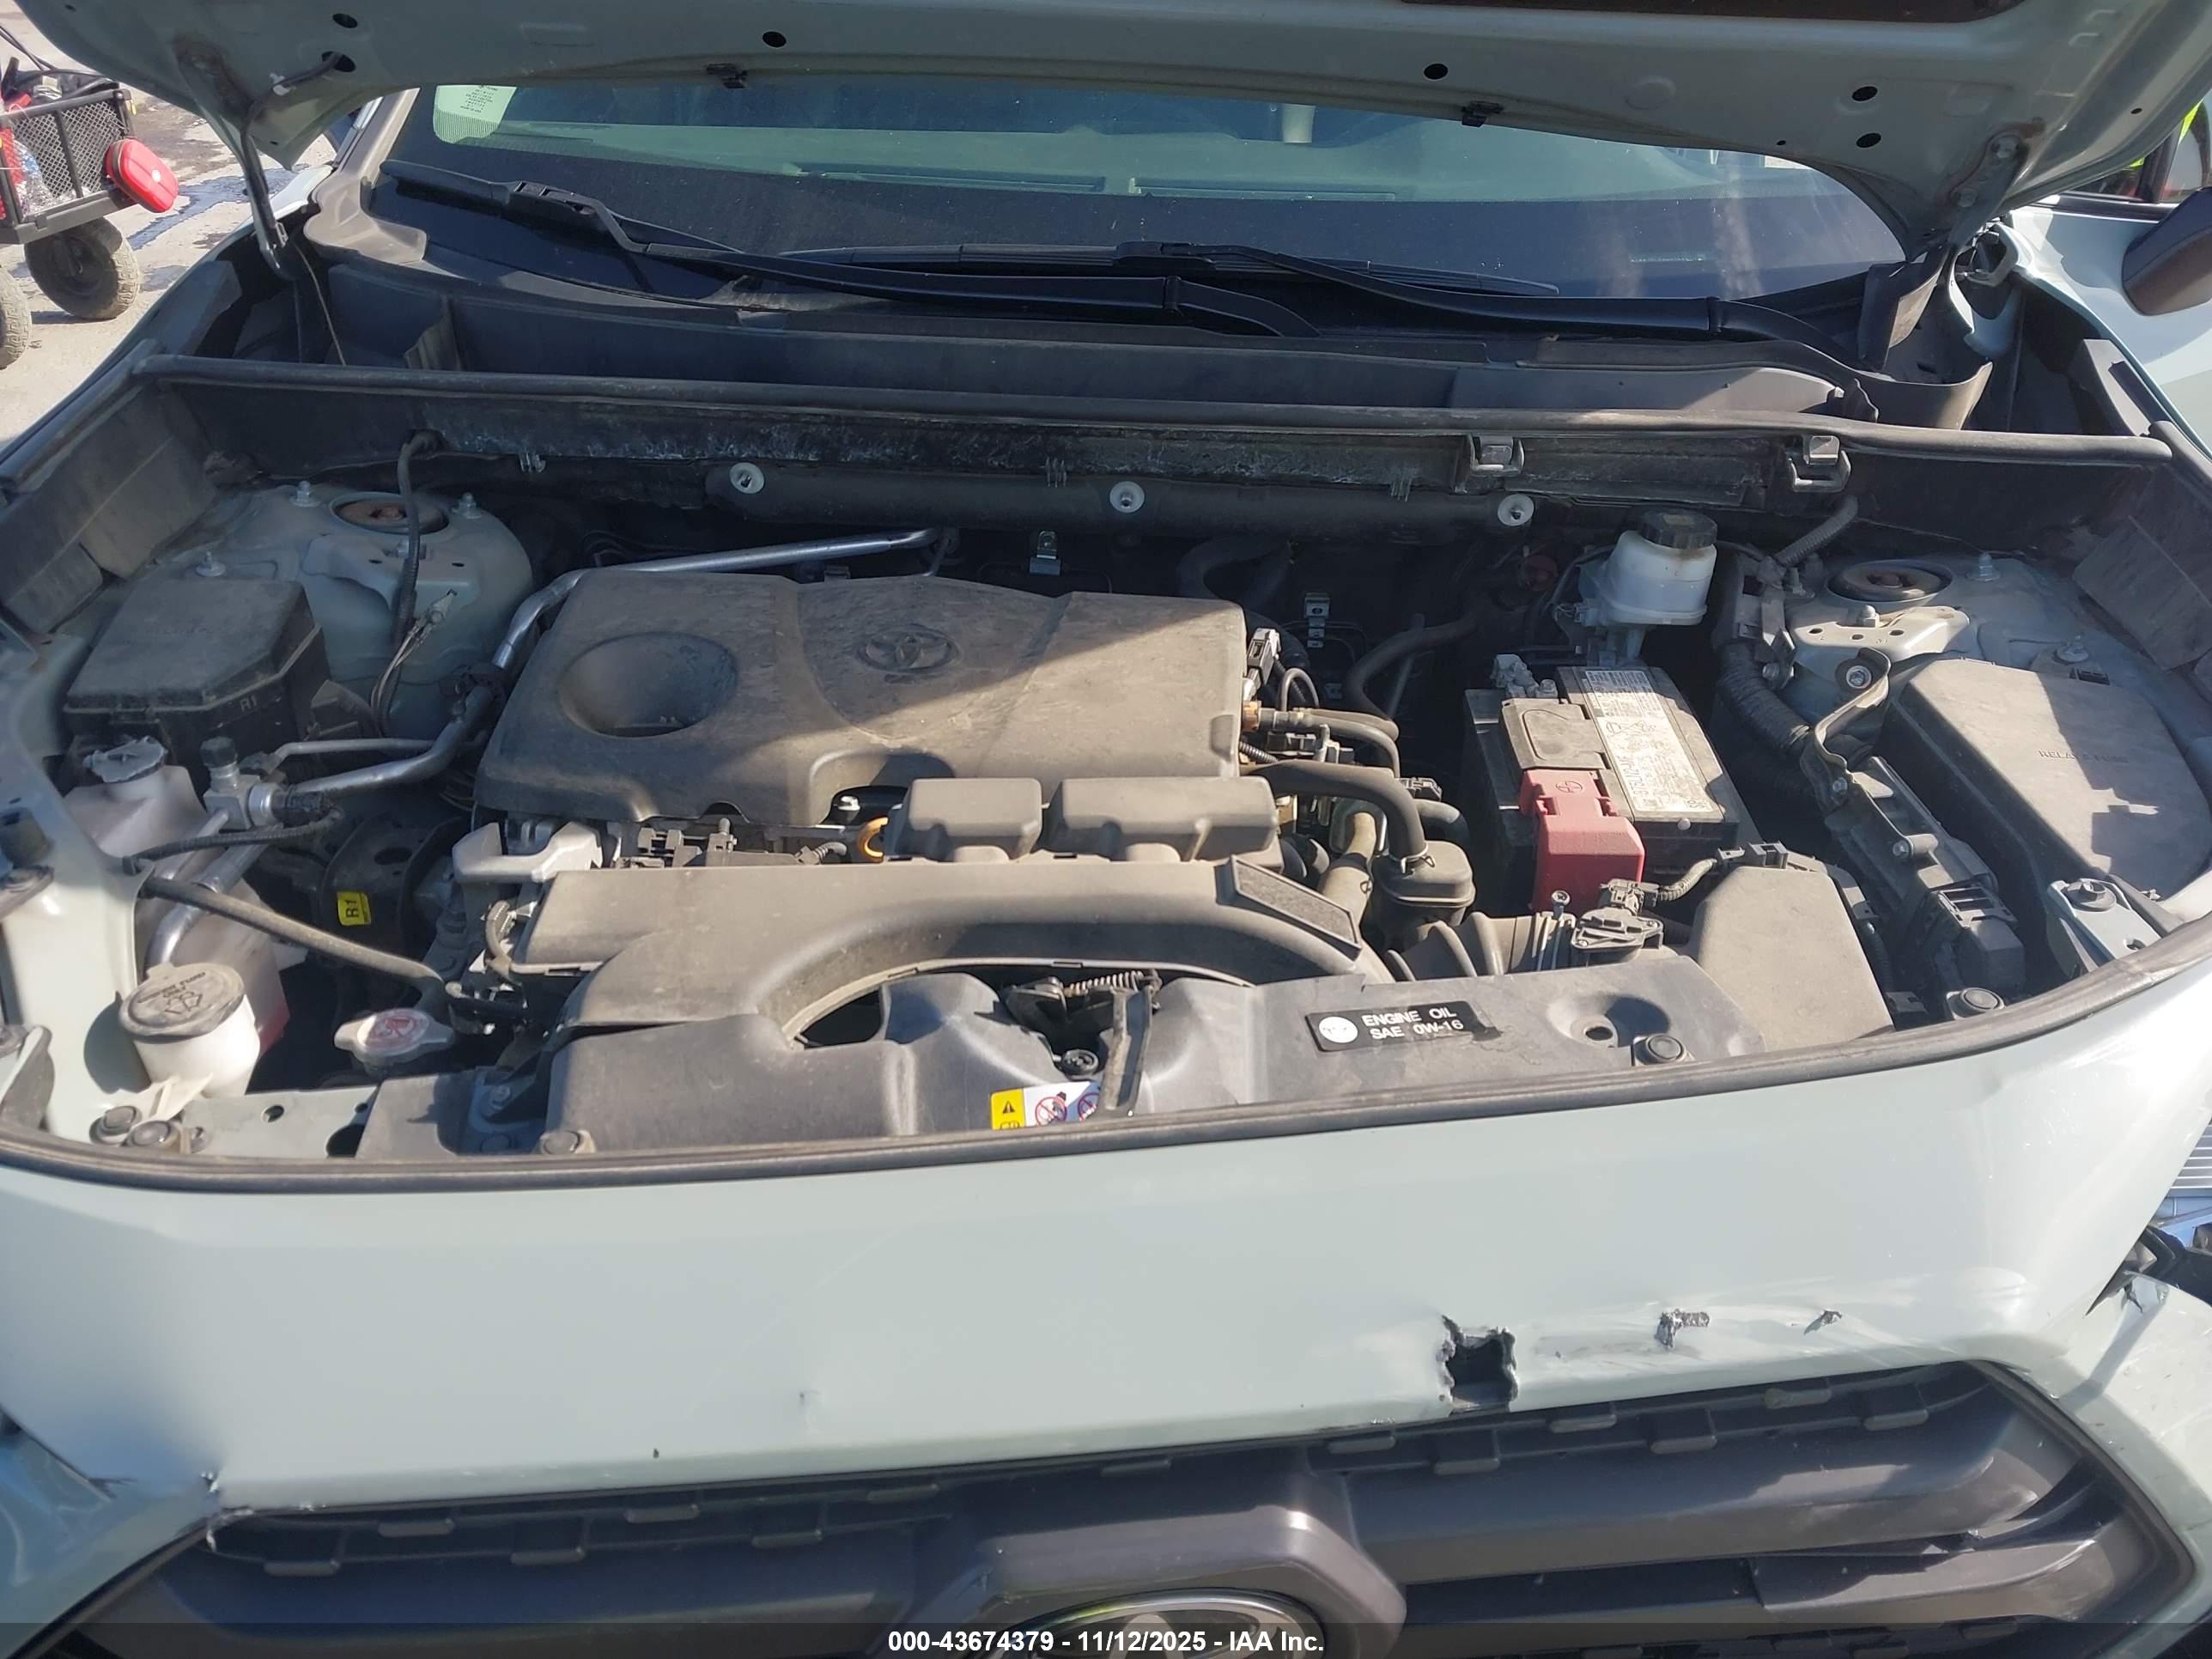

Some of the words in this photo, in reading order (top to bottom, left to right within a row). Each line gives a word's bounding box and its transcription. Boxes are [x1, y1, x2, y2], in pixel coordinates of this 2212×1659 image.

[240, 695, 257, 713] R1
[2038, 750, 2080, 761] RELAY
[344, 900, 360, 918] R1
[1361, 1010, 1423, 1027] ENGINE
[1430, 1006, 1457, 1019] OIL
[1370, 1026, 1405, 1040] SAE
[1413, 1019, 1465, 1036] 0W-16
